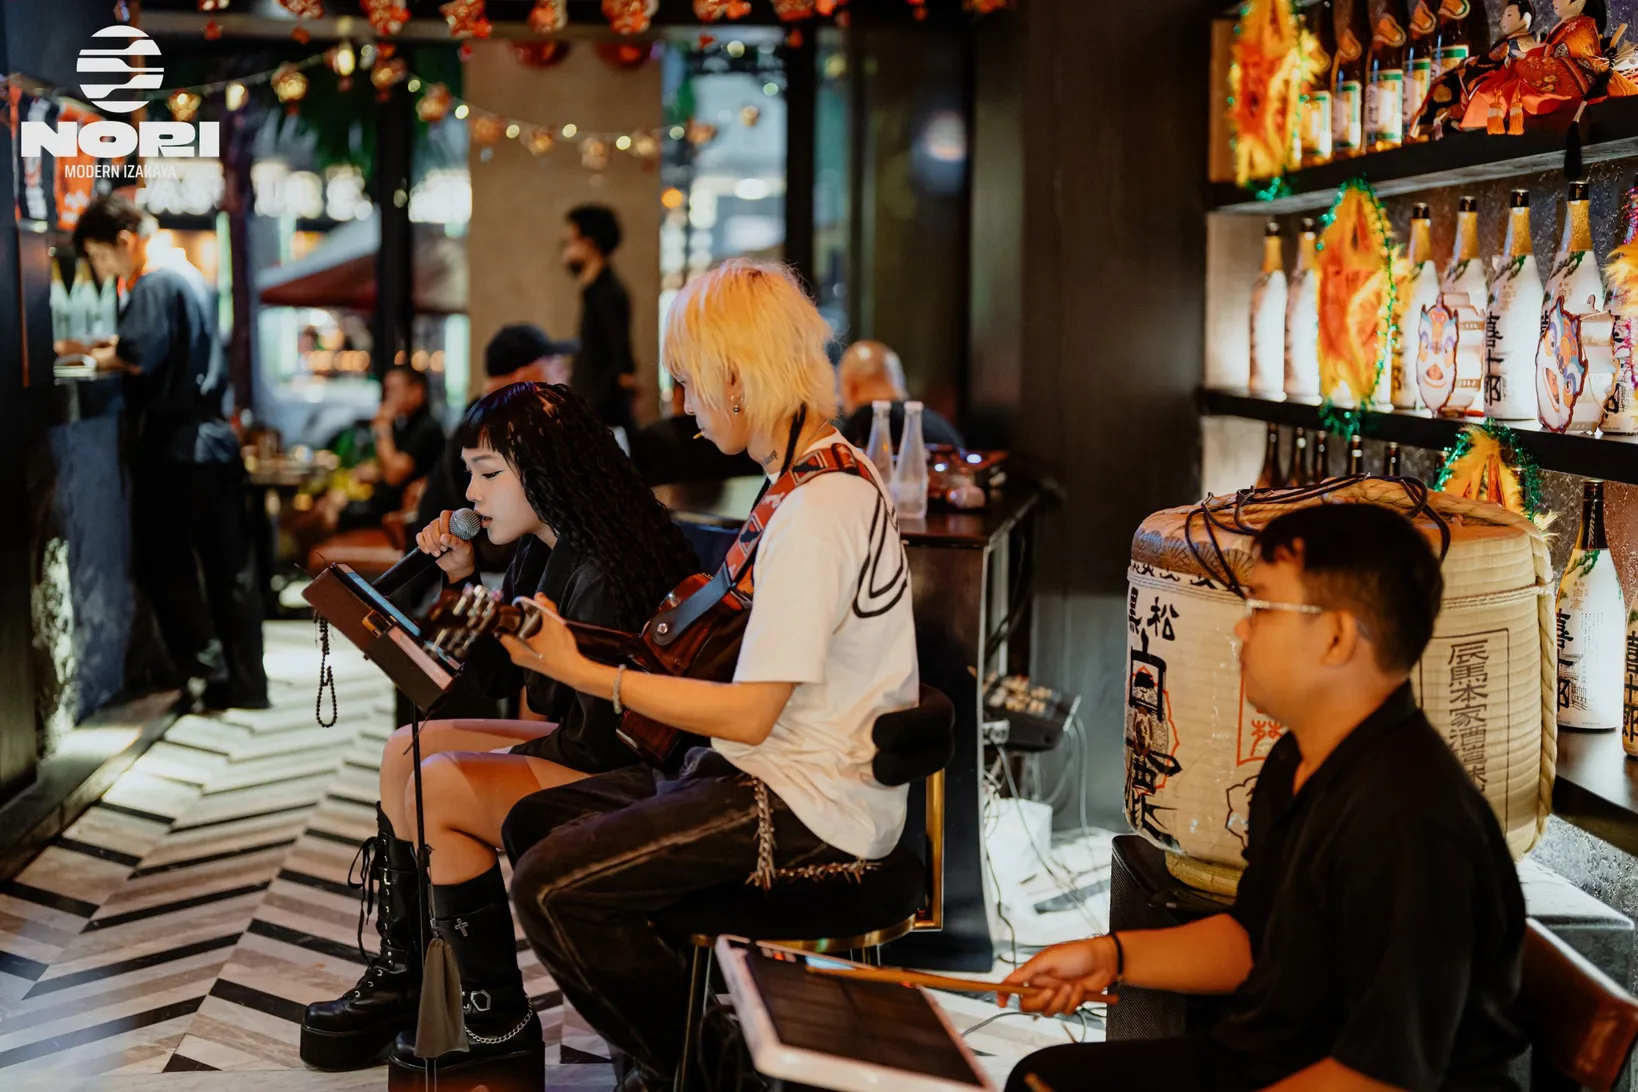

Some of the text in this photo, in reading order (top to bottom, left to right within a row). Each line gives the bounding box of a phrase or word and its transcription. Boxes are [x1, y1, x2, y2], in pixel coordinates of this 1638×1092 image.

[1448, 639, 1490, 793] 辰馬本家酒造
